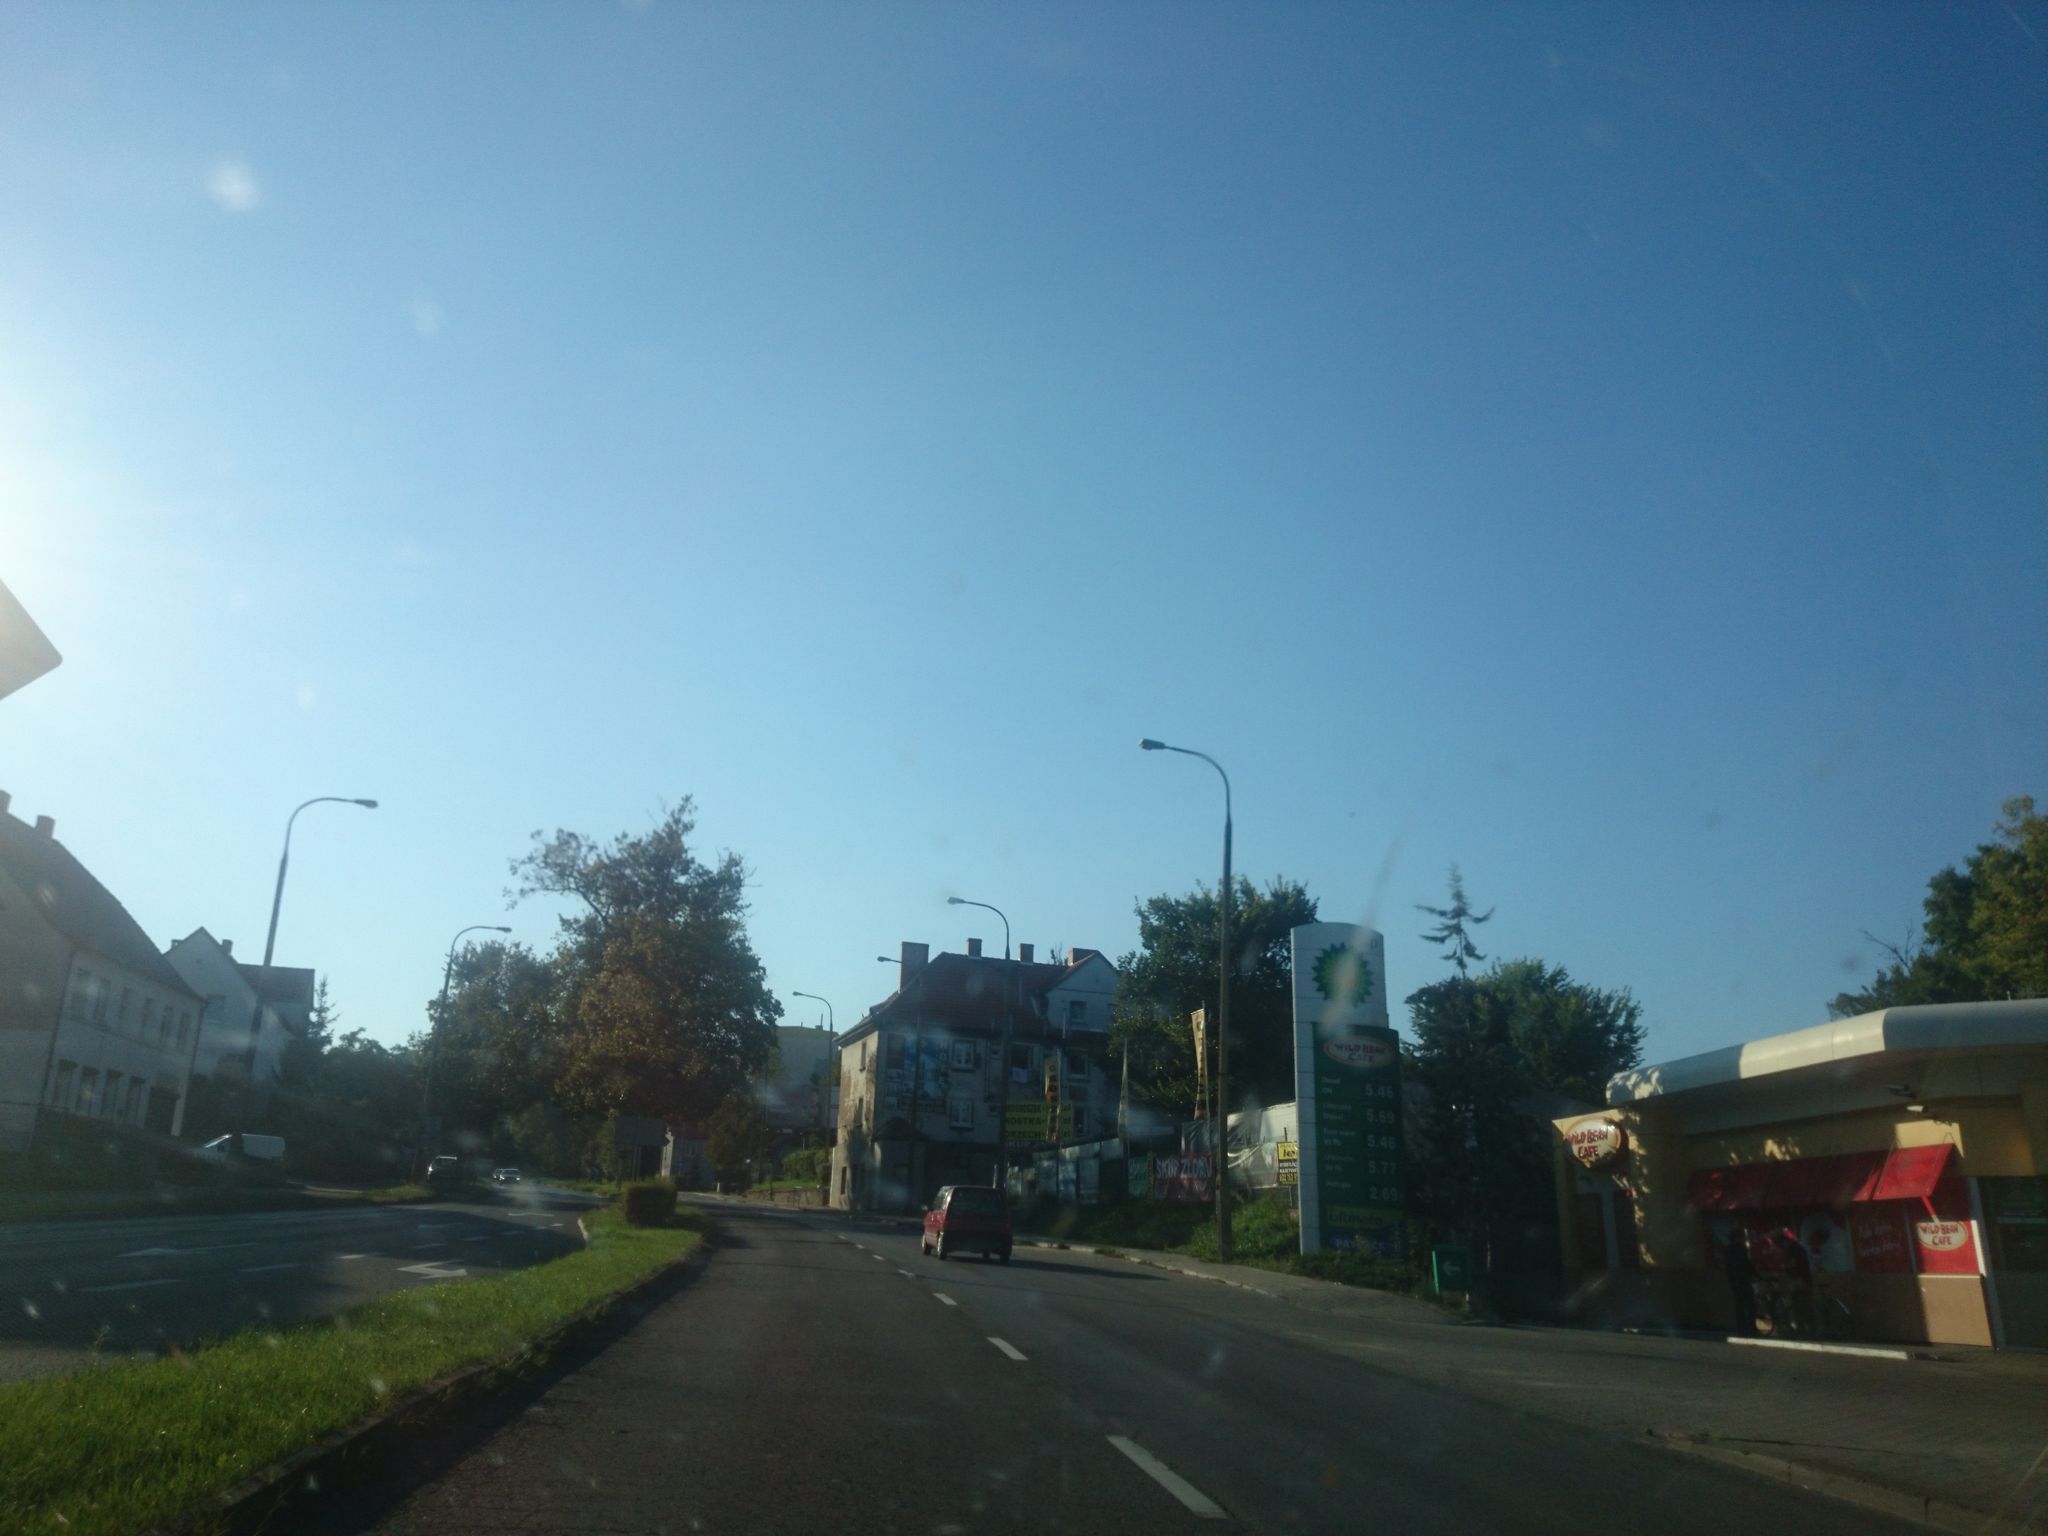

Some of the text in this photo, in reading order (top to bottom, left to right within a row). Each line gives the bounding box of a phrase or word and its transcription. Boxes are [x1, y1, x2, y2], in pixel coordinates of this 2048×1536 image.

[1365, 1083, 1394, 1099] 5.46
[1366, 1108, 1395, 1124] 5.69
[1367, 1134, 1396, 1150] 5.46
[1587, 1128, 1608, 1144] BEAN
[1578, 1145, 1599, 1159] CAFE
[1368, 1160, 1397, 1176] 5.77
[1369, 1185, 1398, 1201] 2.69
[1919, 1223, 1959, 1235] WILD BEAN
[1932, 1235, 1952, 1246] CAFE
